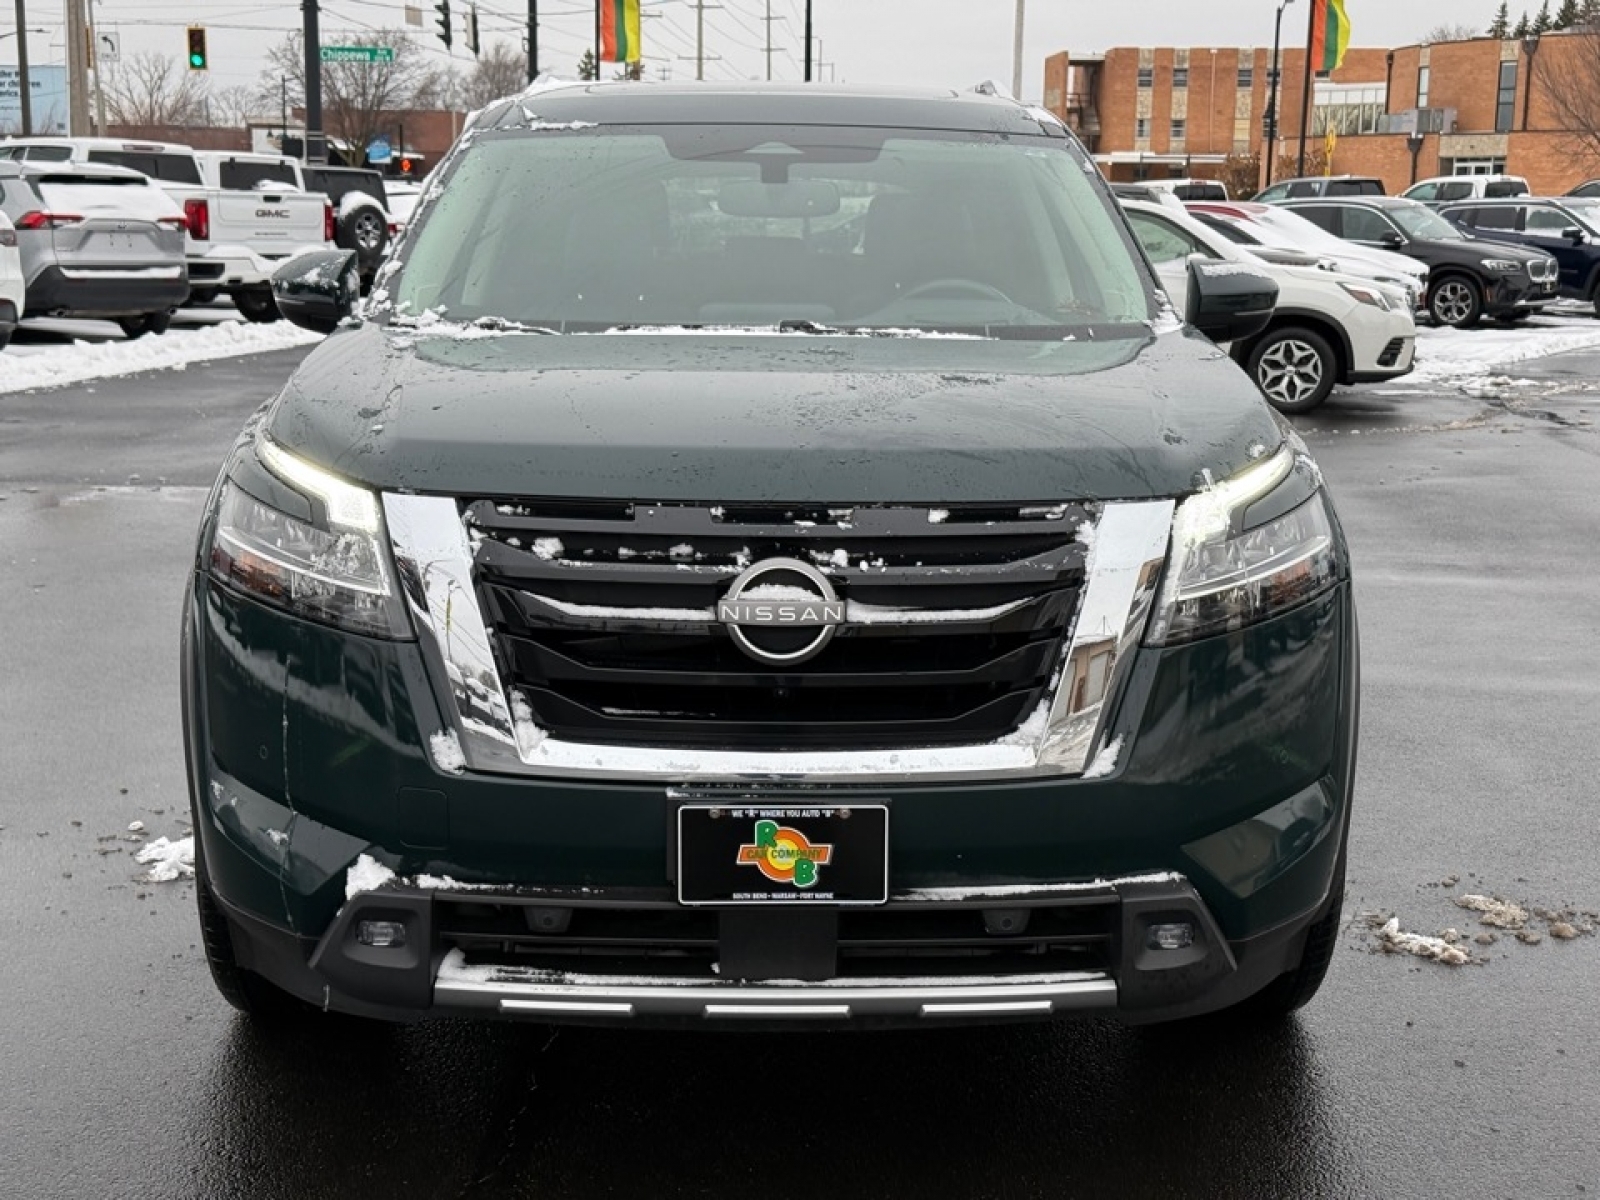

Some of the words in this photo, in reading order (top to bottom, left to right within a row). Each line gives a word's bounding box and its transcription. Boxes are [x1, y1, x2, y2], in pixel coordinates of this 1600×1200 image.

[255, 209, 290, 219] GMC
[721, 605, 841, 621] NISSAN
[732, 810, 743, 818] WE
[760, 810, 785, 818] WHERE
[787, 810, 800, 818] YOU
[801, 810, 820, 818] AUTO
[755, 820, 779, 848] R
[771, 849, 822, 859] COMPANY
[793, 858, 819, 887] B
